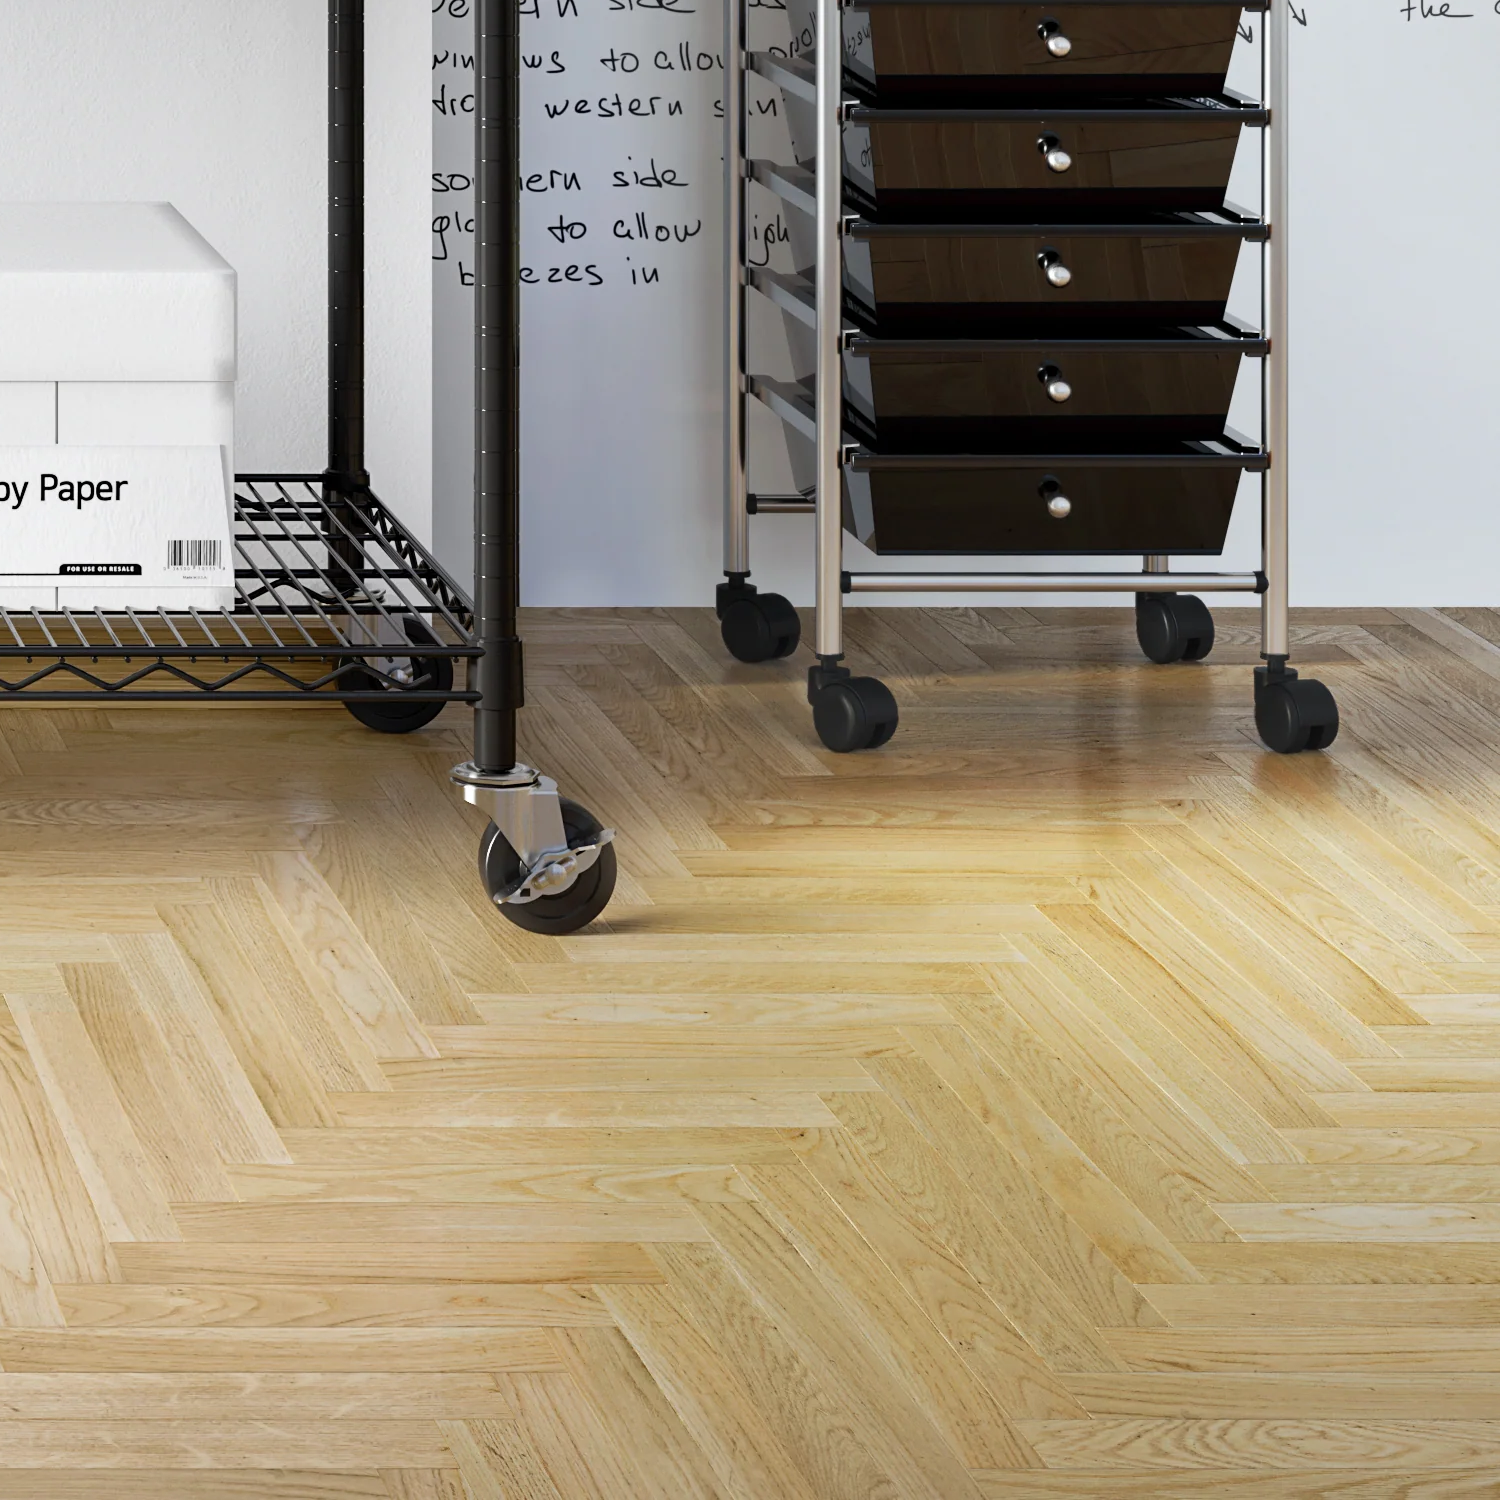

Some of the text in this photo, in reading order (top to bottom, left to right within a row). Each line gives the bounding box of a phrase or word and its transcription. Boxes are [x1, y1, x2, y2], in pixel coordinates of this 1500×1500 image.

[599, 47, 640, 74] to
[653, 40, 724, 72] allo
[544, 92, 683, 120] western
[612, 155, 690, 189] side
[546, 214, 588, 244] to
[612, 211, 702, 243] allow
[630, 256, 660, 286] in
[40, 473, 129, 511] Paper
[66, 565, 81, 573] FOR
[81, 565, 96, 573] USE
[97, 565, 107, 573] OR
